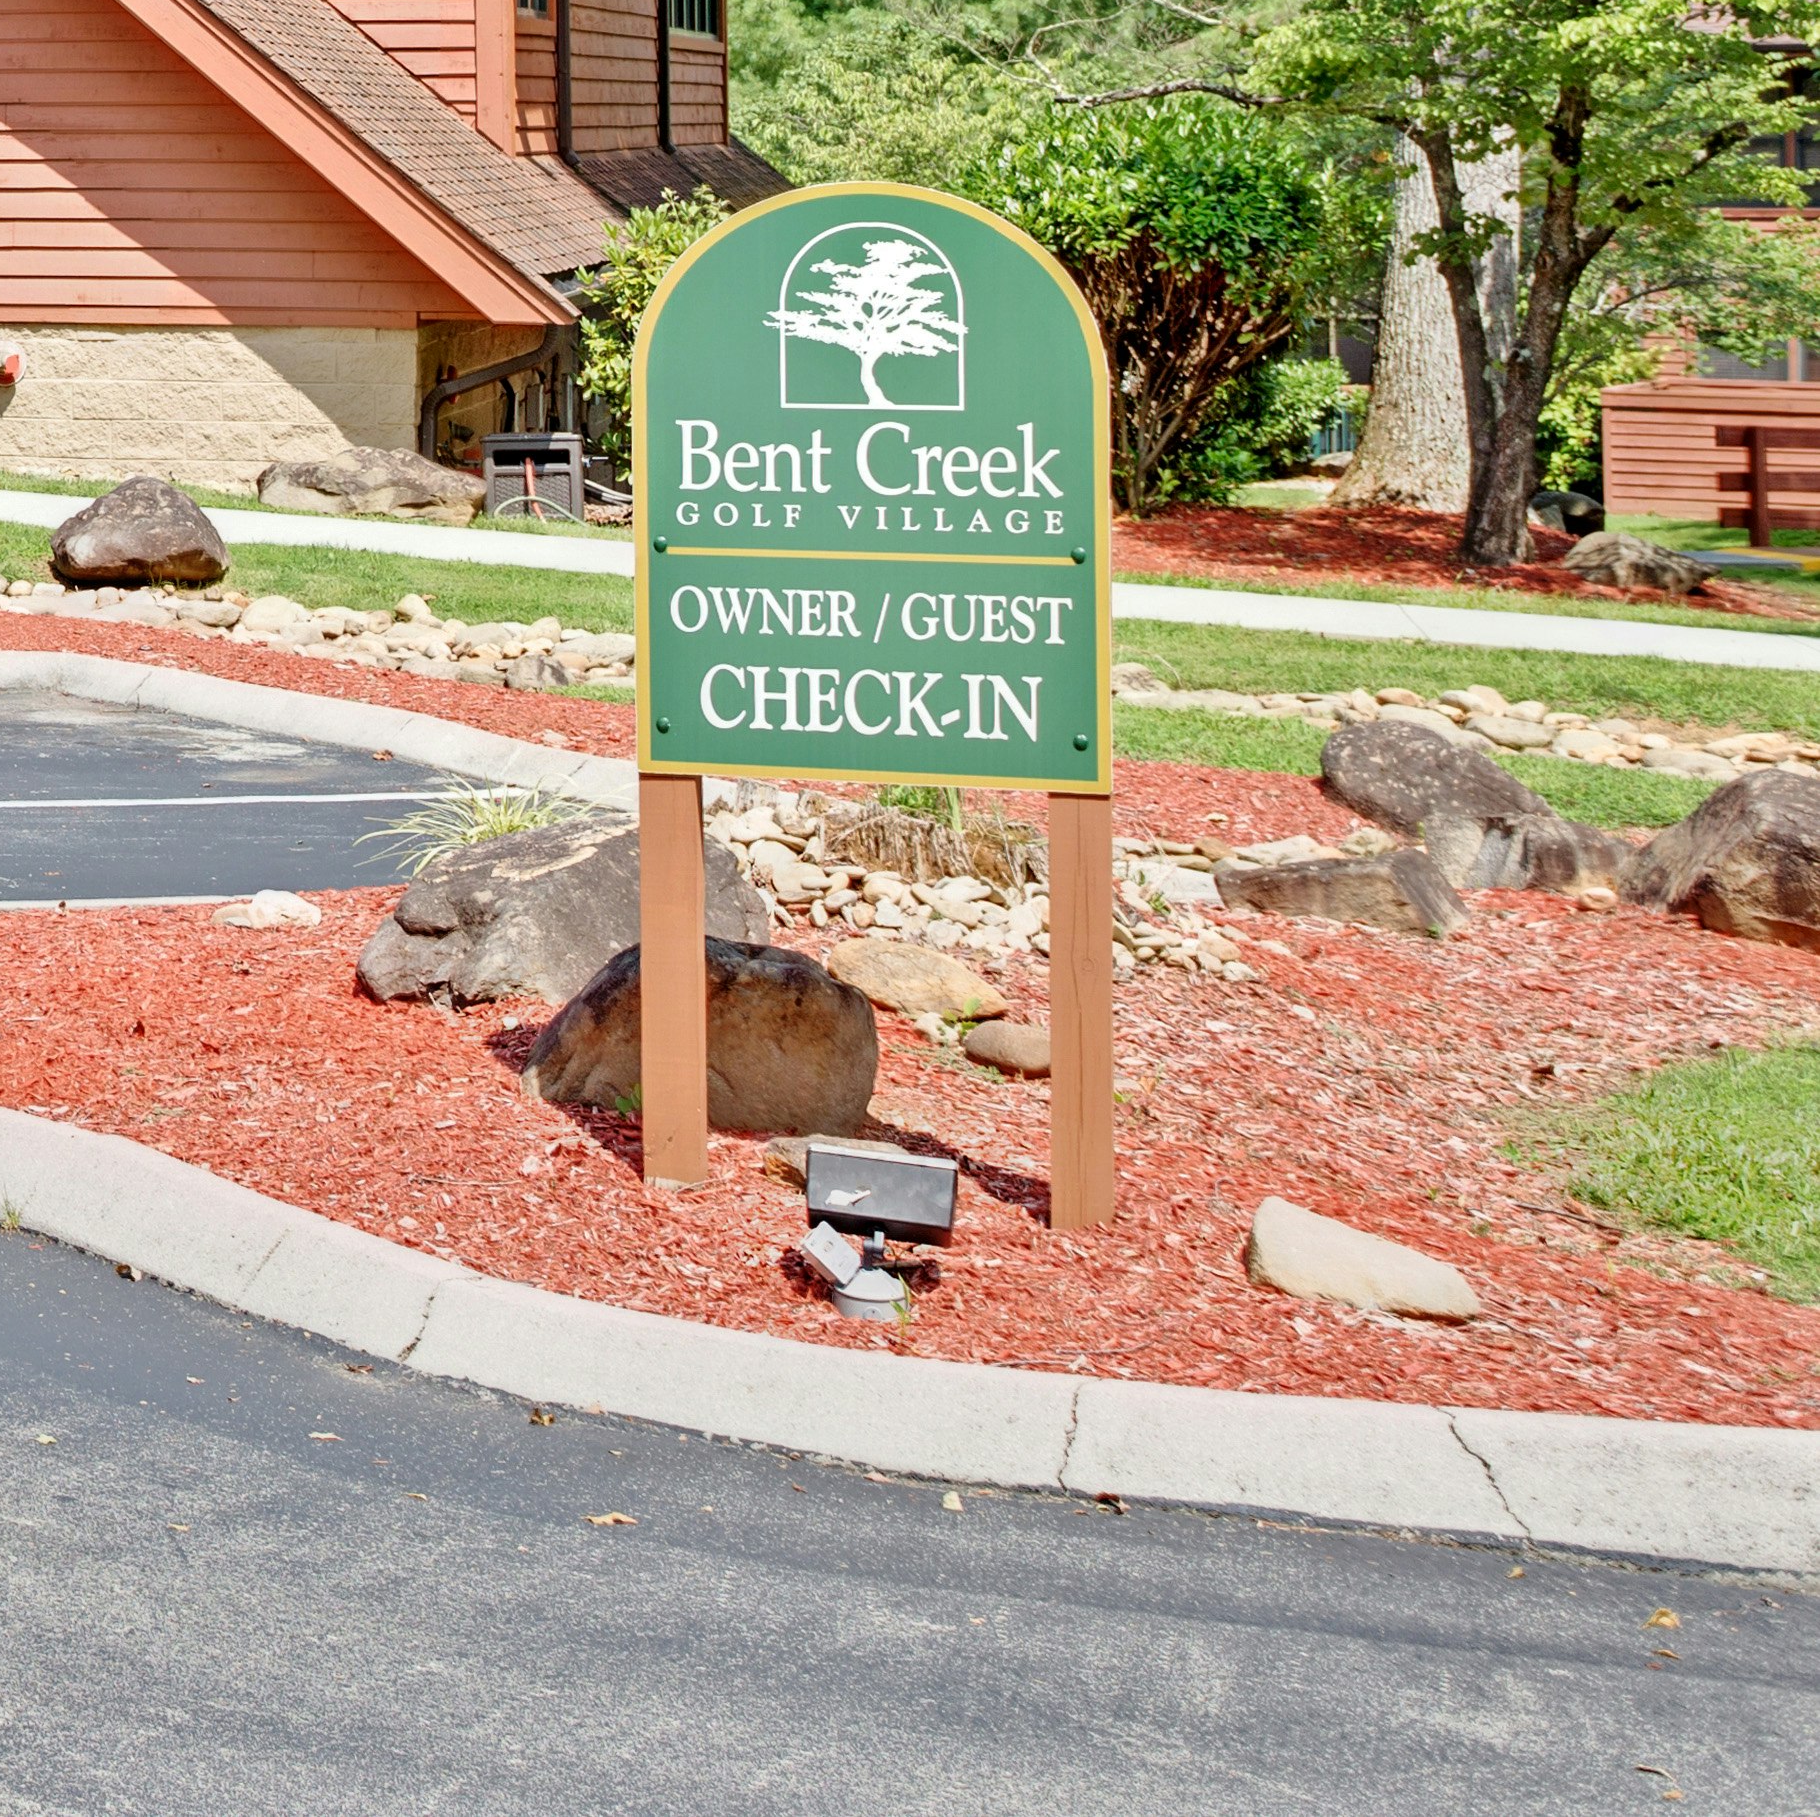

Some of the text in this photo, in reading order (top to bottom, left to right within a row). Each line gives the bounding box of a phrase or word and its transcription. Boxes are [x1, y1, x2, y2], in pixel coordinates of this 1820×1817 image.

[674, 419, 1064, 499] Bent Creek
[675, 501, 1065, 535] GOLF VILLAGE
[700, 663, 1043, 743] CHECK-IN
